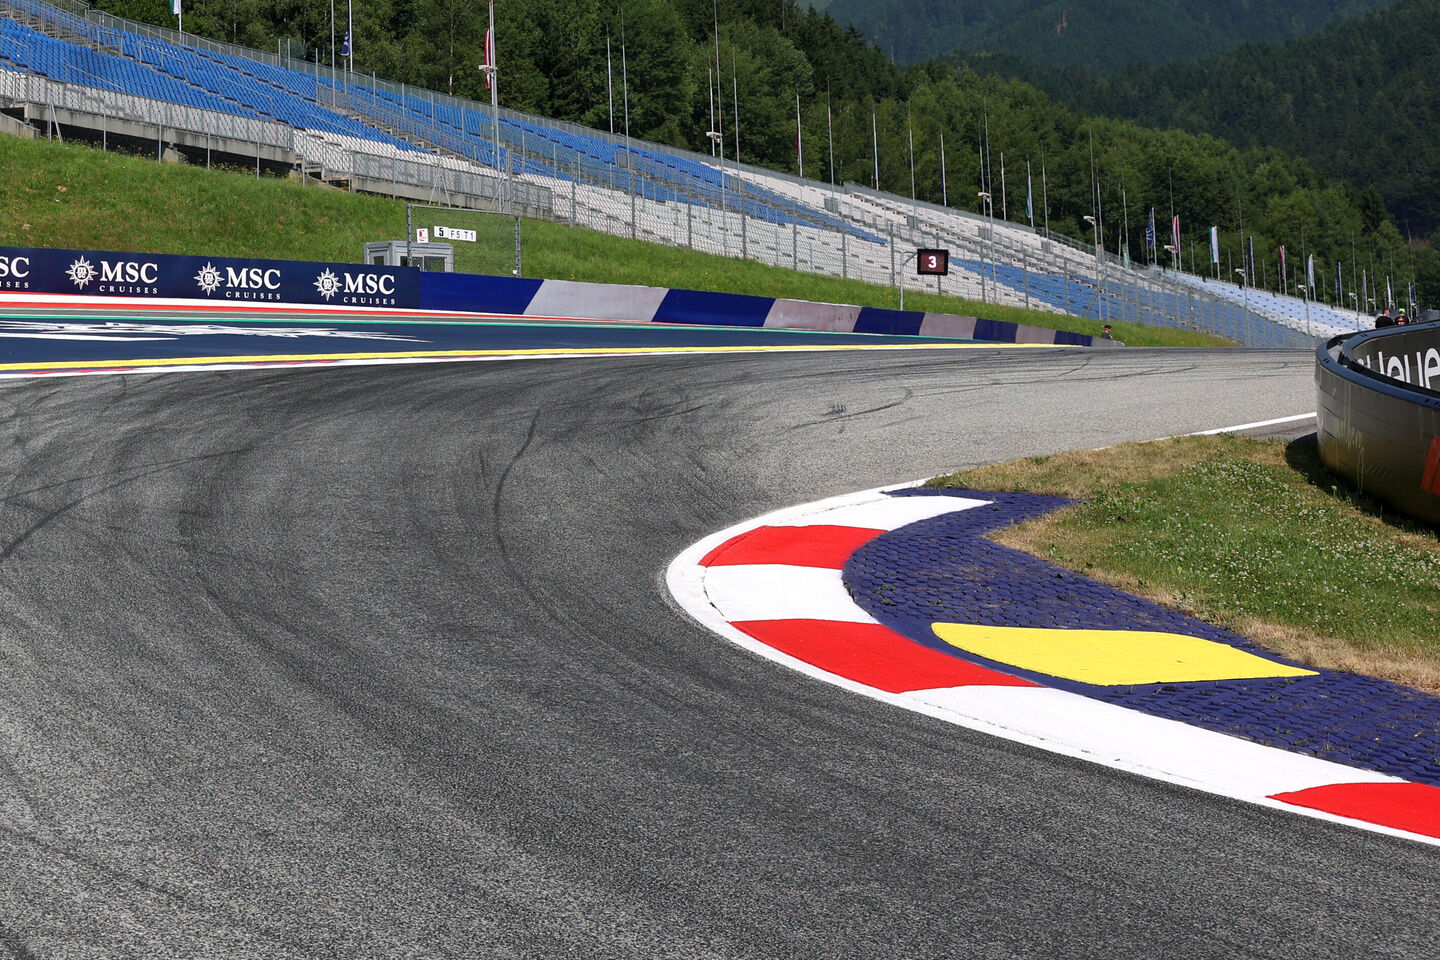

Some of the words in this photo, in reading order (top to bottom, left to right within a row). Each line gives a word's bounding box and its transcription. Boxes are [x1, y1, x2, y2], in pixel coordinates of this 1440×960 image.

[438, 227, 445, 237] 5
[928, 255, 937, 269] 3
[99, 261, 158, 283] MSC
[225, 267, 281, 289] MSC
[99, 286, 158, 294] CRUISES
[343, 273, 395, 295] MSC
[225, 292, 281, 300] CRUISES
[343, 297, 395, 305] CRUISES
